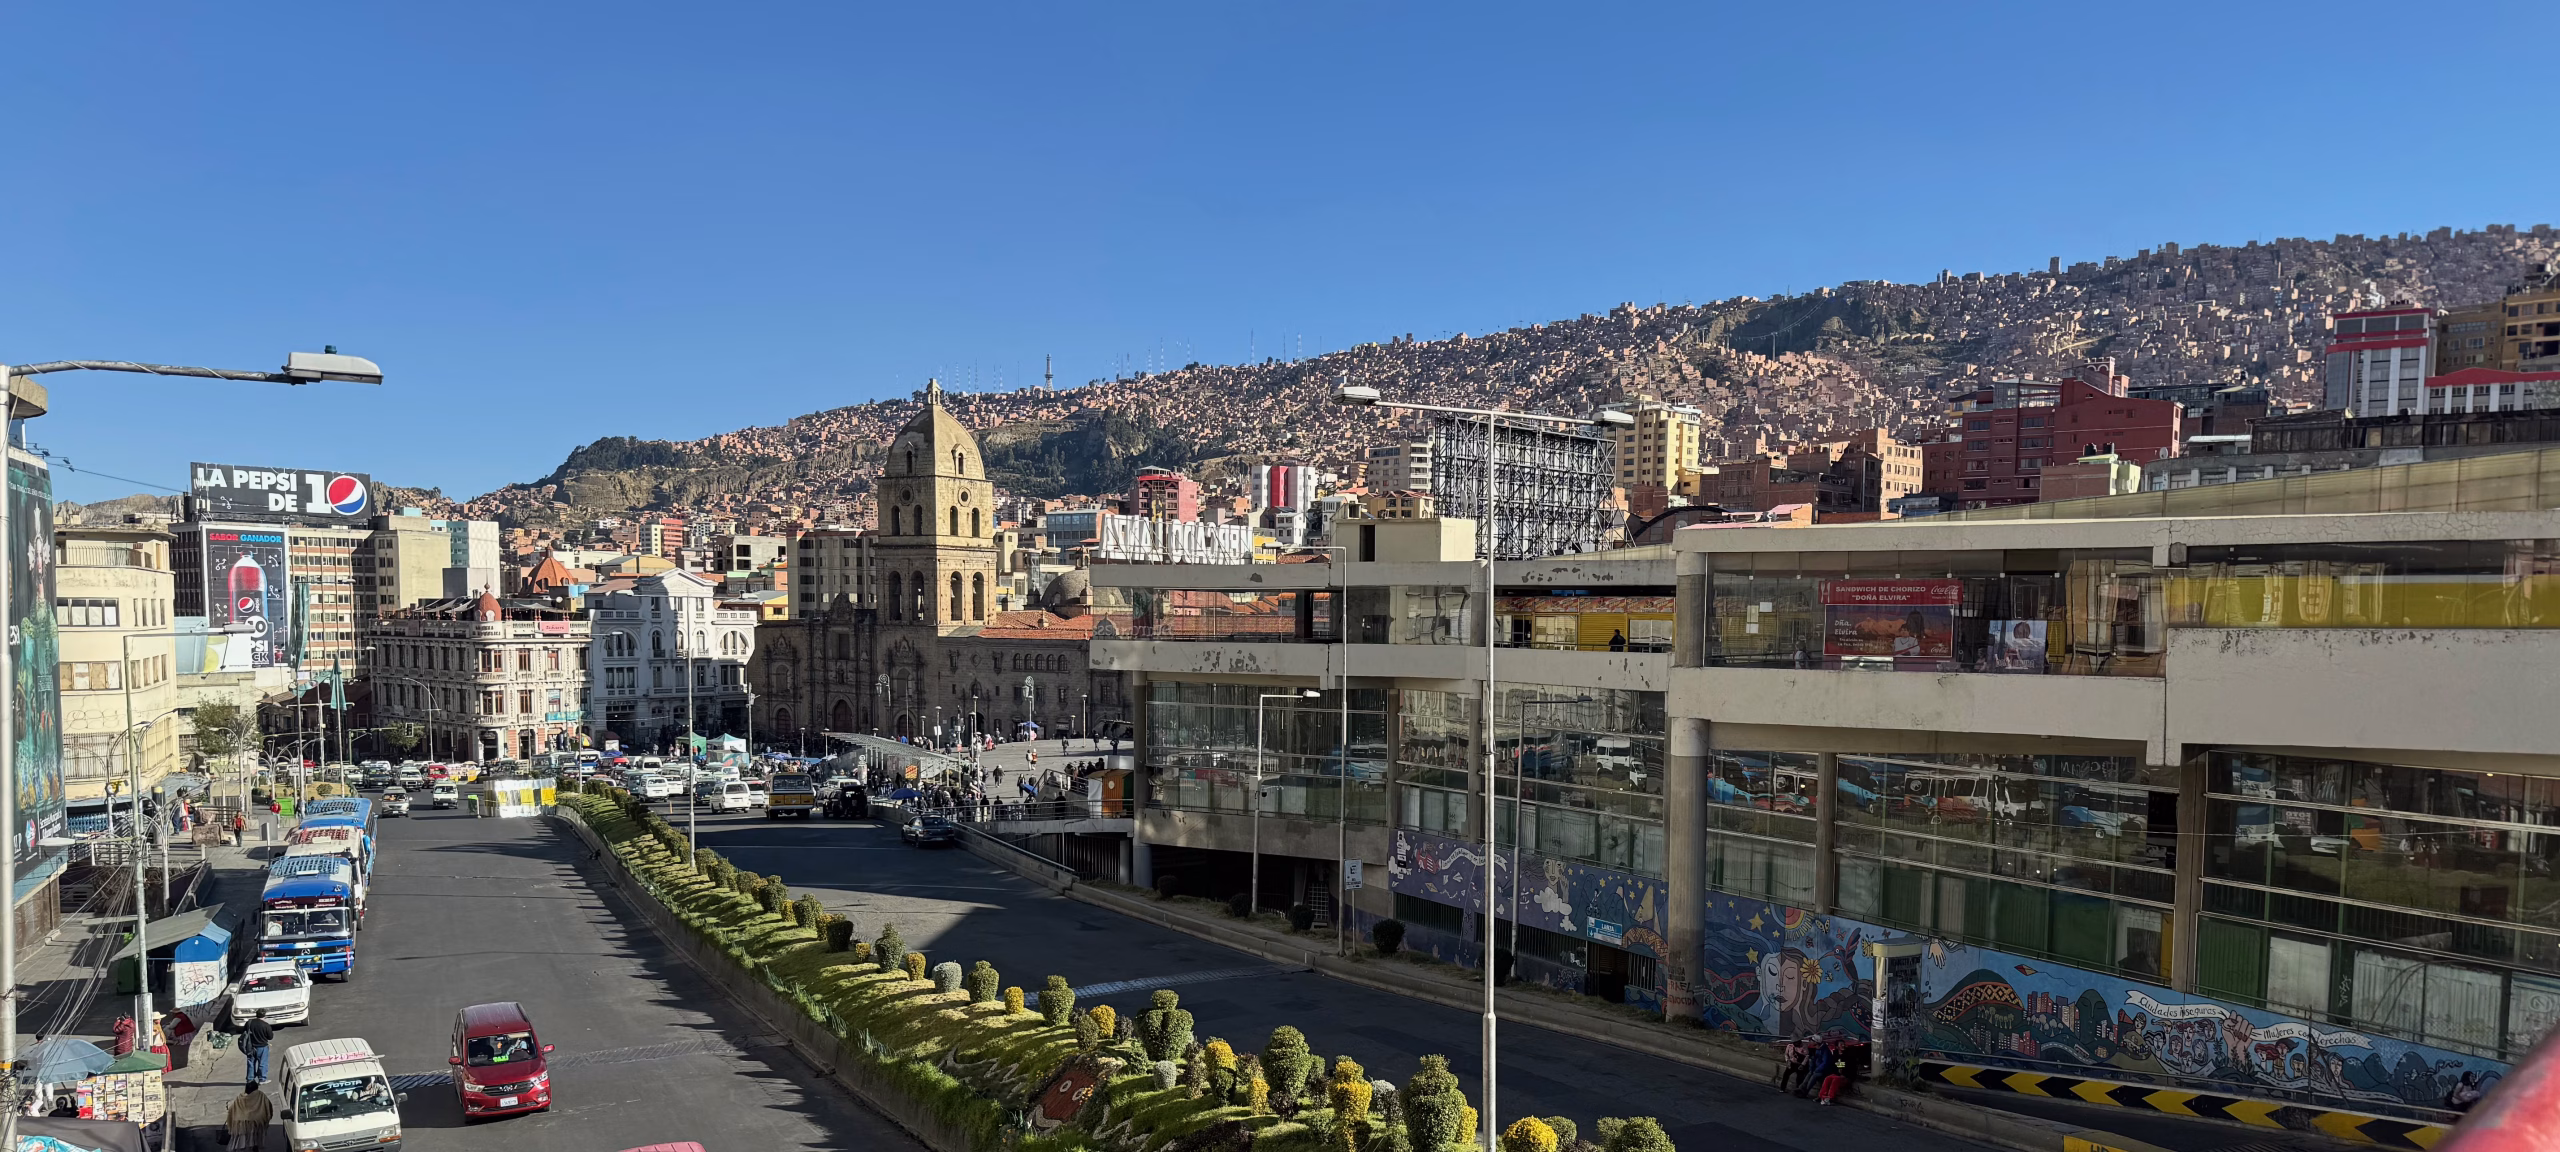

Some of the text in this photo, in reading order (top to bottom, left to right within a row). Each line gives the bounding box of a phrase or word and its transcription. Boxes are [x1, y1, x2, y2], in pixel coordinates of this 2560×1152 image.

[197, 467, 298, 492] LA PEPSI
[268, 493, 298, 513] DE
[209, 532, 283, 543] SABOR GANADOR
[1834, 628, 1858, 636] Elvira
[2139, 996, 2178, 1017] Ciudades
[328, 1080, 363, 1089] TOYOTA
